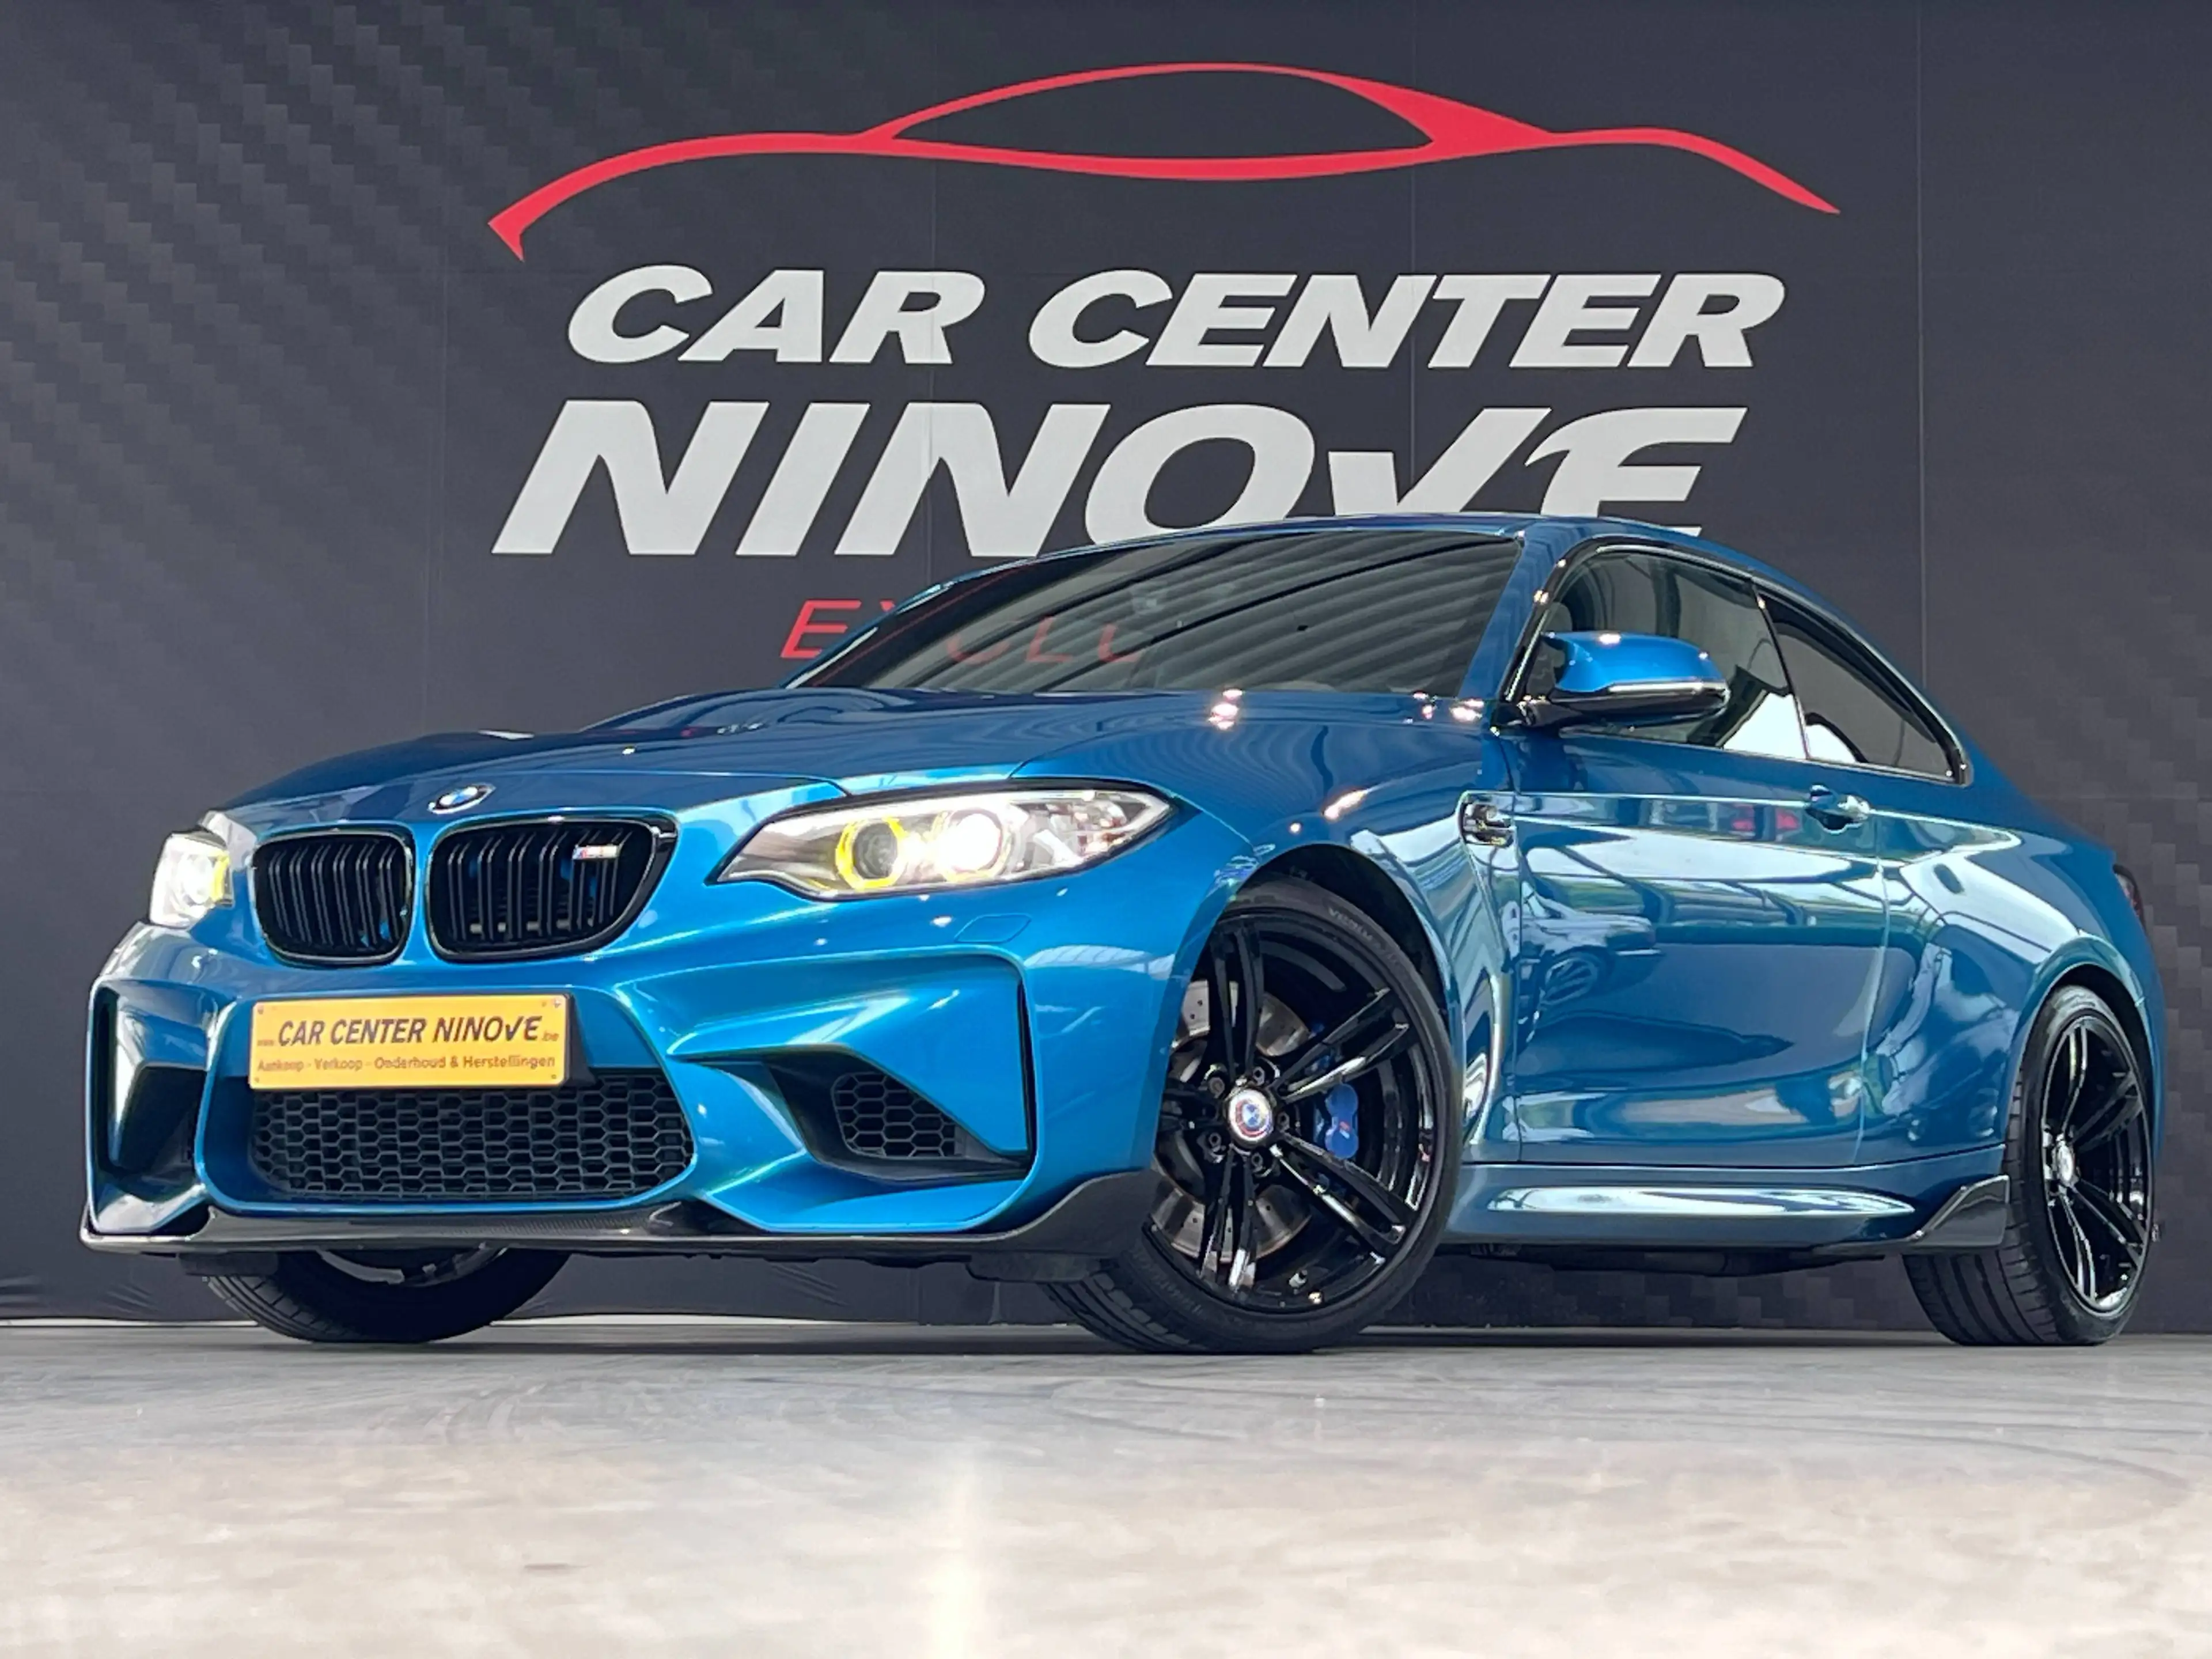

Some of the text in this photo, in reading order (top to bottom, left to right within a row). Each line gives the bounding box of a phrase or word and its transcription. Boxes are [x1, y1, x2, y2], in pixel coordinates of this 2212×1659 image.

[568, 264, 1785, 369] CAR CENTER
[491, 400, 1748, 558] NINOVE
[279, 1020, 325, 1047] CAR
[330, 1018, 427, 1046] CENTER
[433, 1015, 543, 1044] NINOVE
[374, 1056, 446, 1069] Onderhoud
[449, 1056, 459, 1068] &
[463, 1054, 556, 1069] Herstellingen
